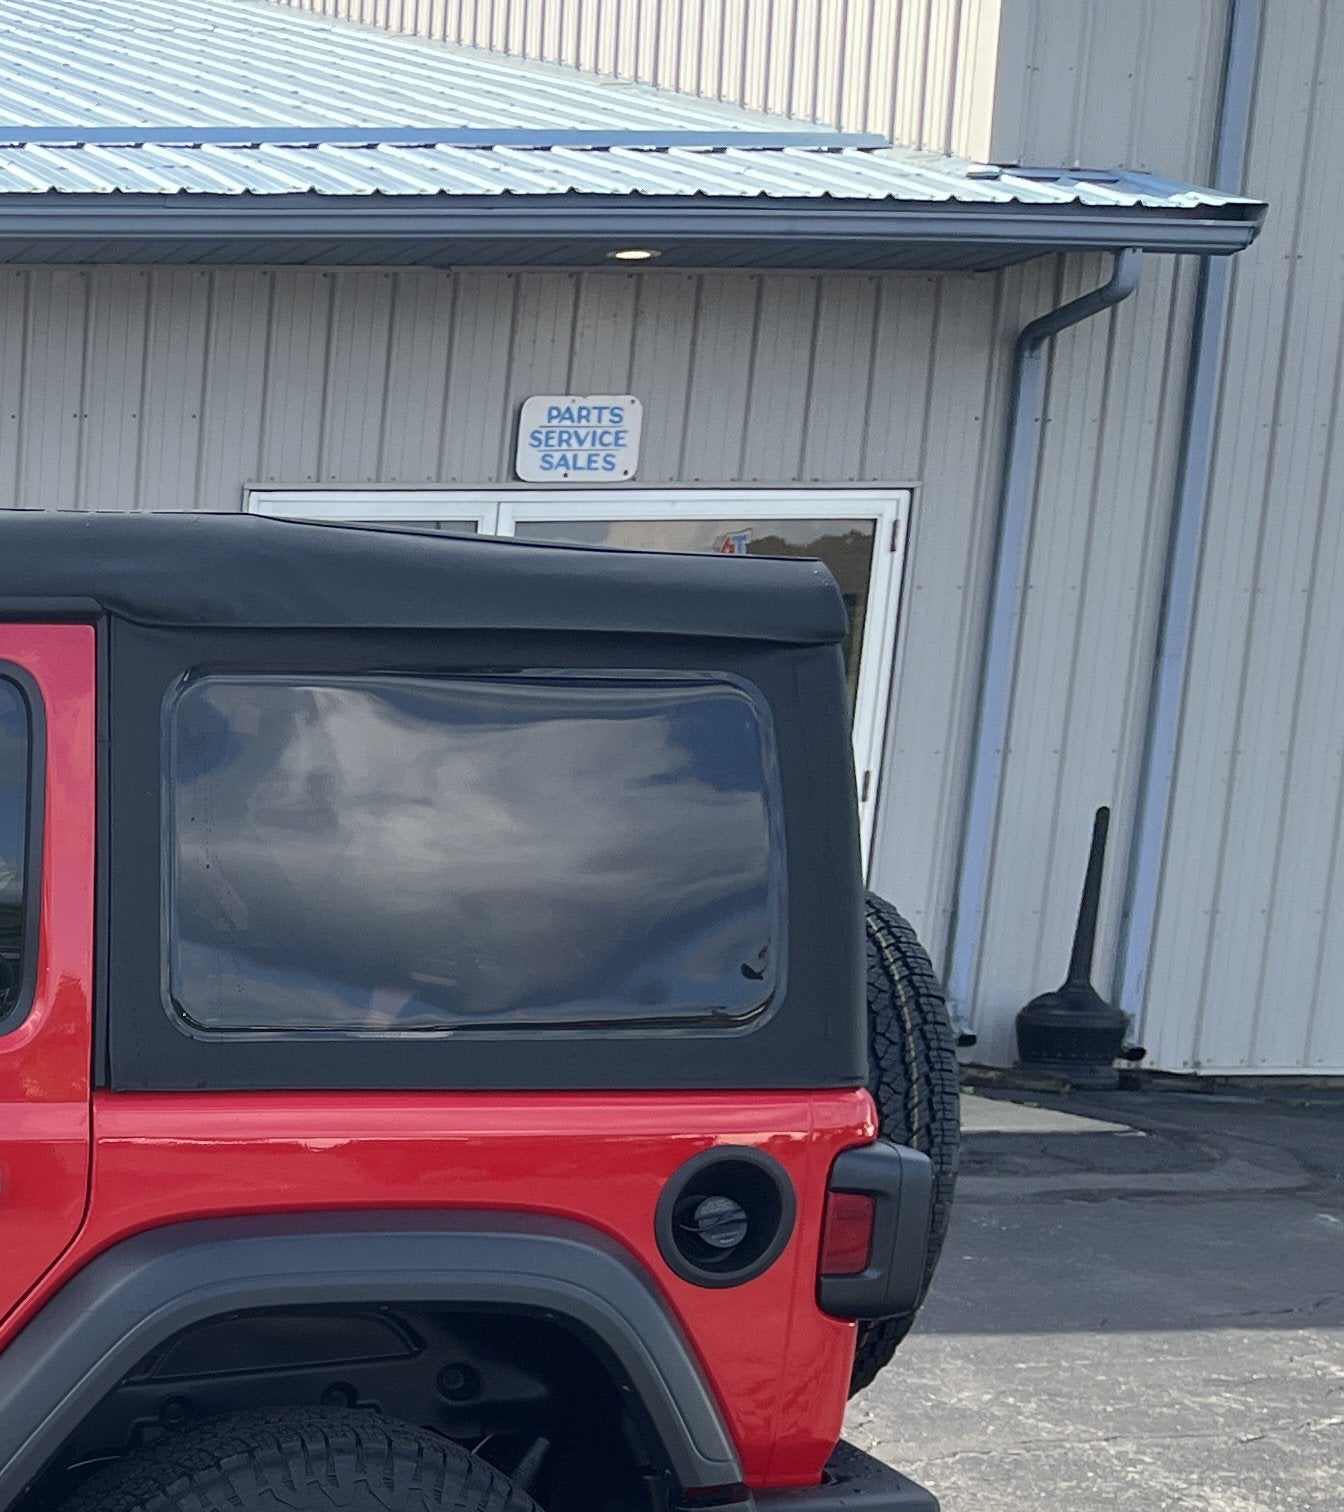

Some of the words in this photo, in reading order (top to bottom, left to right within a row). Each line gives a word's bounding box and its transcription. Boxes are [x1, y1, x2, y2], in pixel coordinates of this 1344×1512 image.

[547, 406, 625, 424] PARTS
[529, 429, 629, 448] SERVICE
[539, 453, 617, 471] SALES
